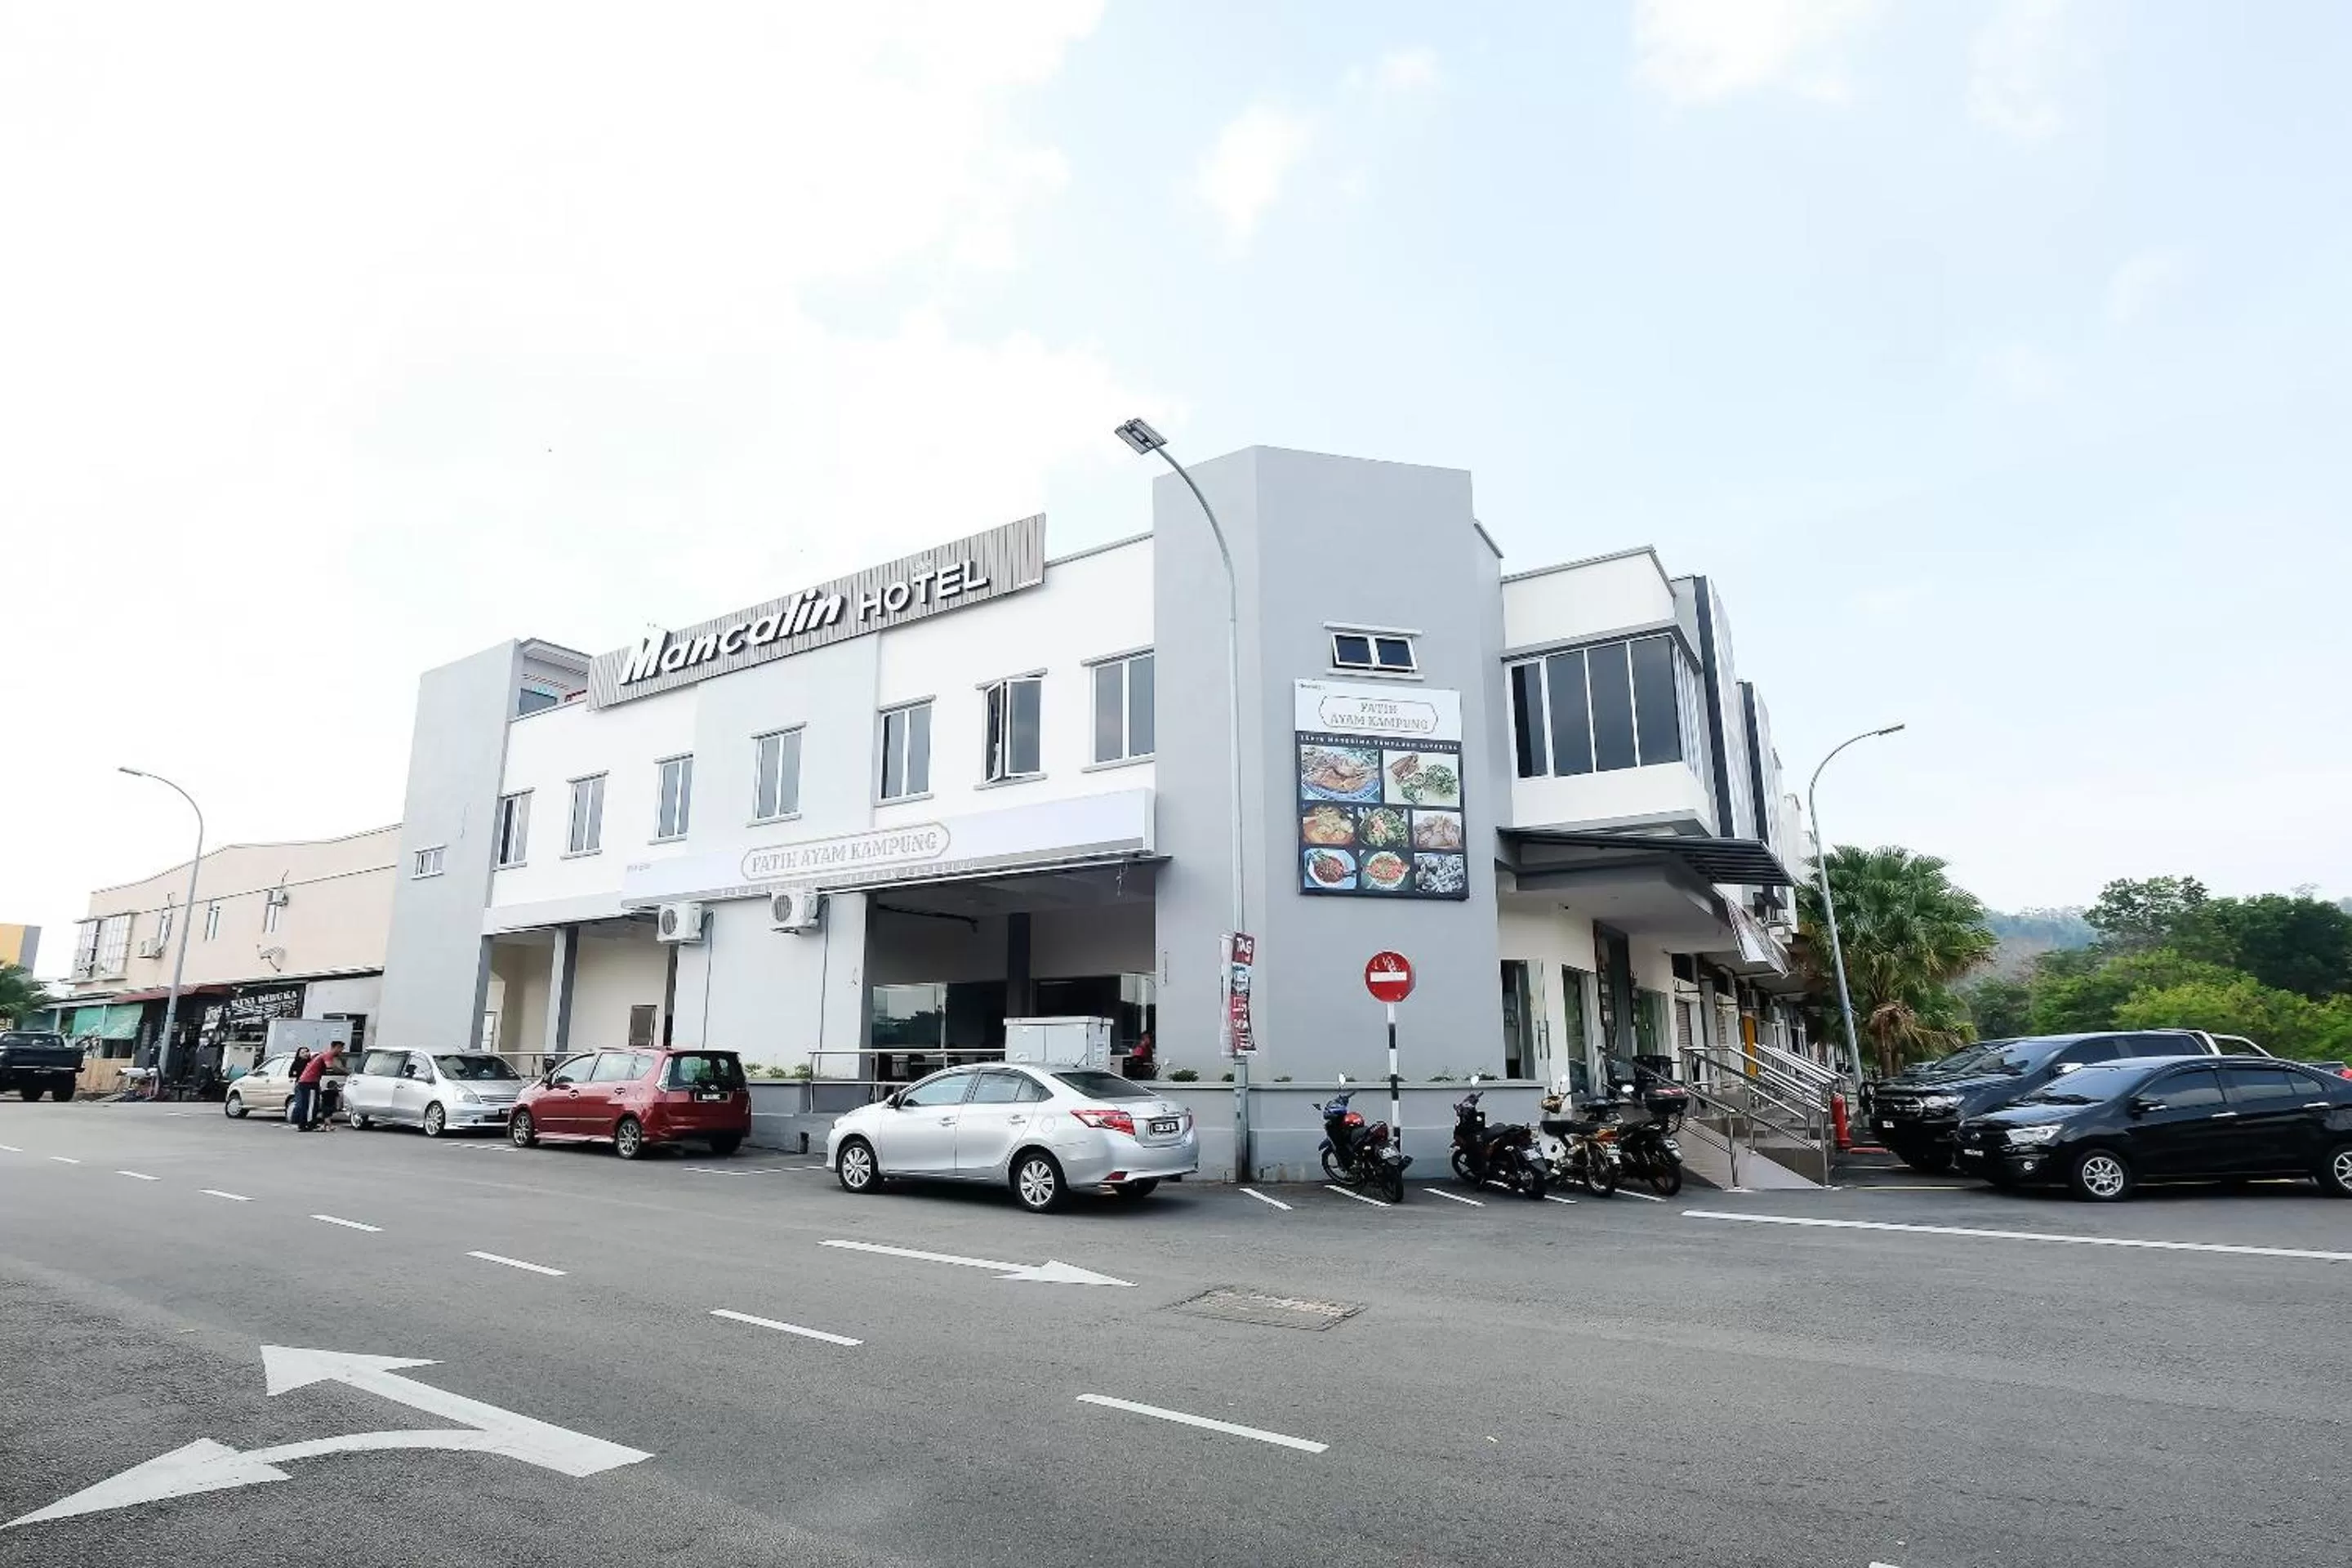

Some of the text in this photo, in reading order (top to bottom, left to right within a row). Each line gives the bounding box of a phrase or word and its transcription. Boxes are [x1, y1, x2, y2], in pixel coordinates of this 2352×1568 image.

[619, 559, 988, 685] Mancalin HOTEL
[1330, 713, 1428, 729] AYAM KAMPUNG
[800, 844, 846, 867] AYAM
[851, 831, 938, 860] KAMPUNG
